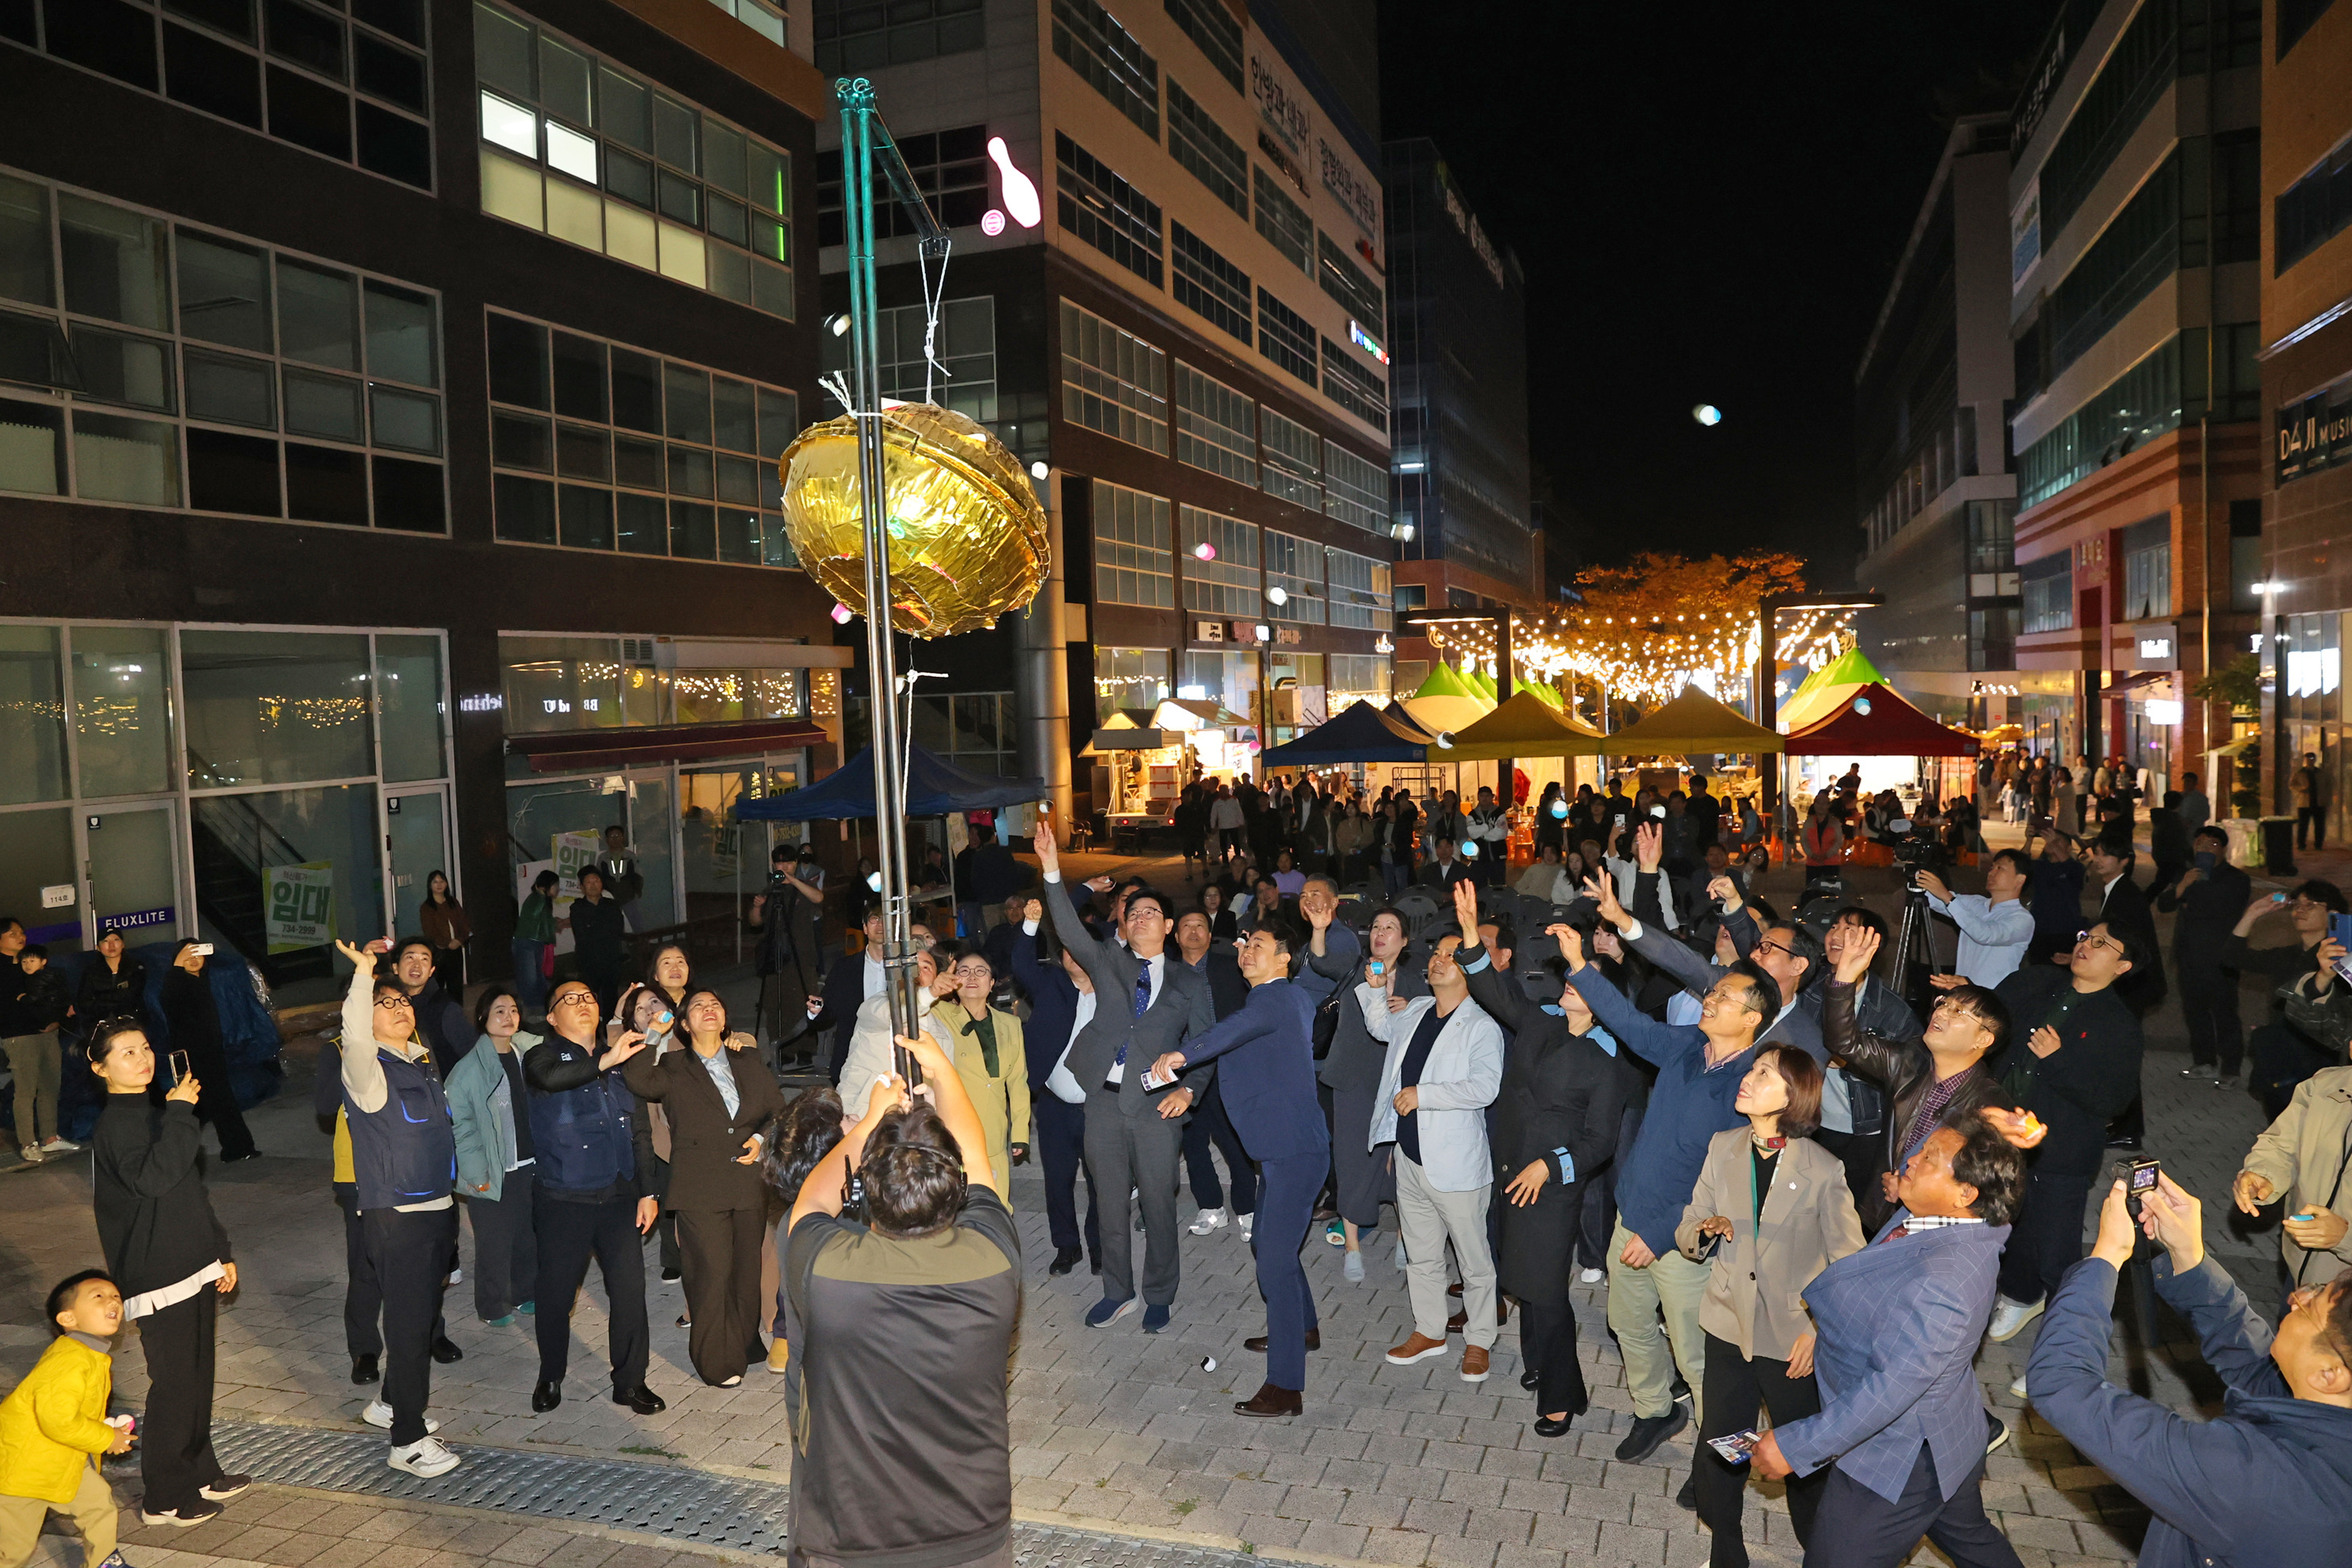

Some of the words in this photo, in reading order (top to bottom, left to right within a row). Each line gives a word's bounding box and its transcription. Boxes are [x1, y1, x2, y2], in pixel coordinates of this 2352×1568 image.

[2319, 415, 2352, 446] MUSI
[273, 881, 331, 925] 임대
[105, 910, 166, 929] FLUXLITE
[282, 923, 316, 935] 734-2999
